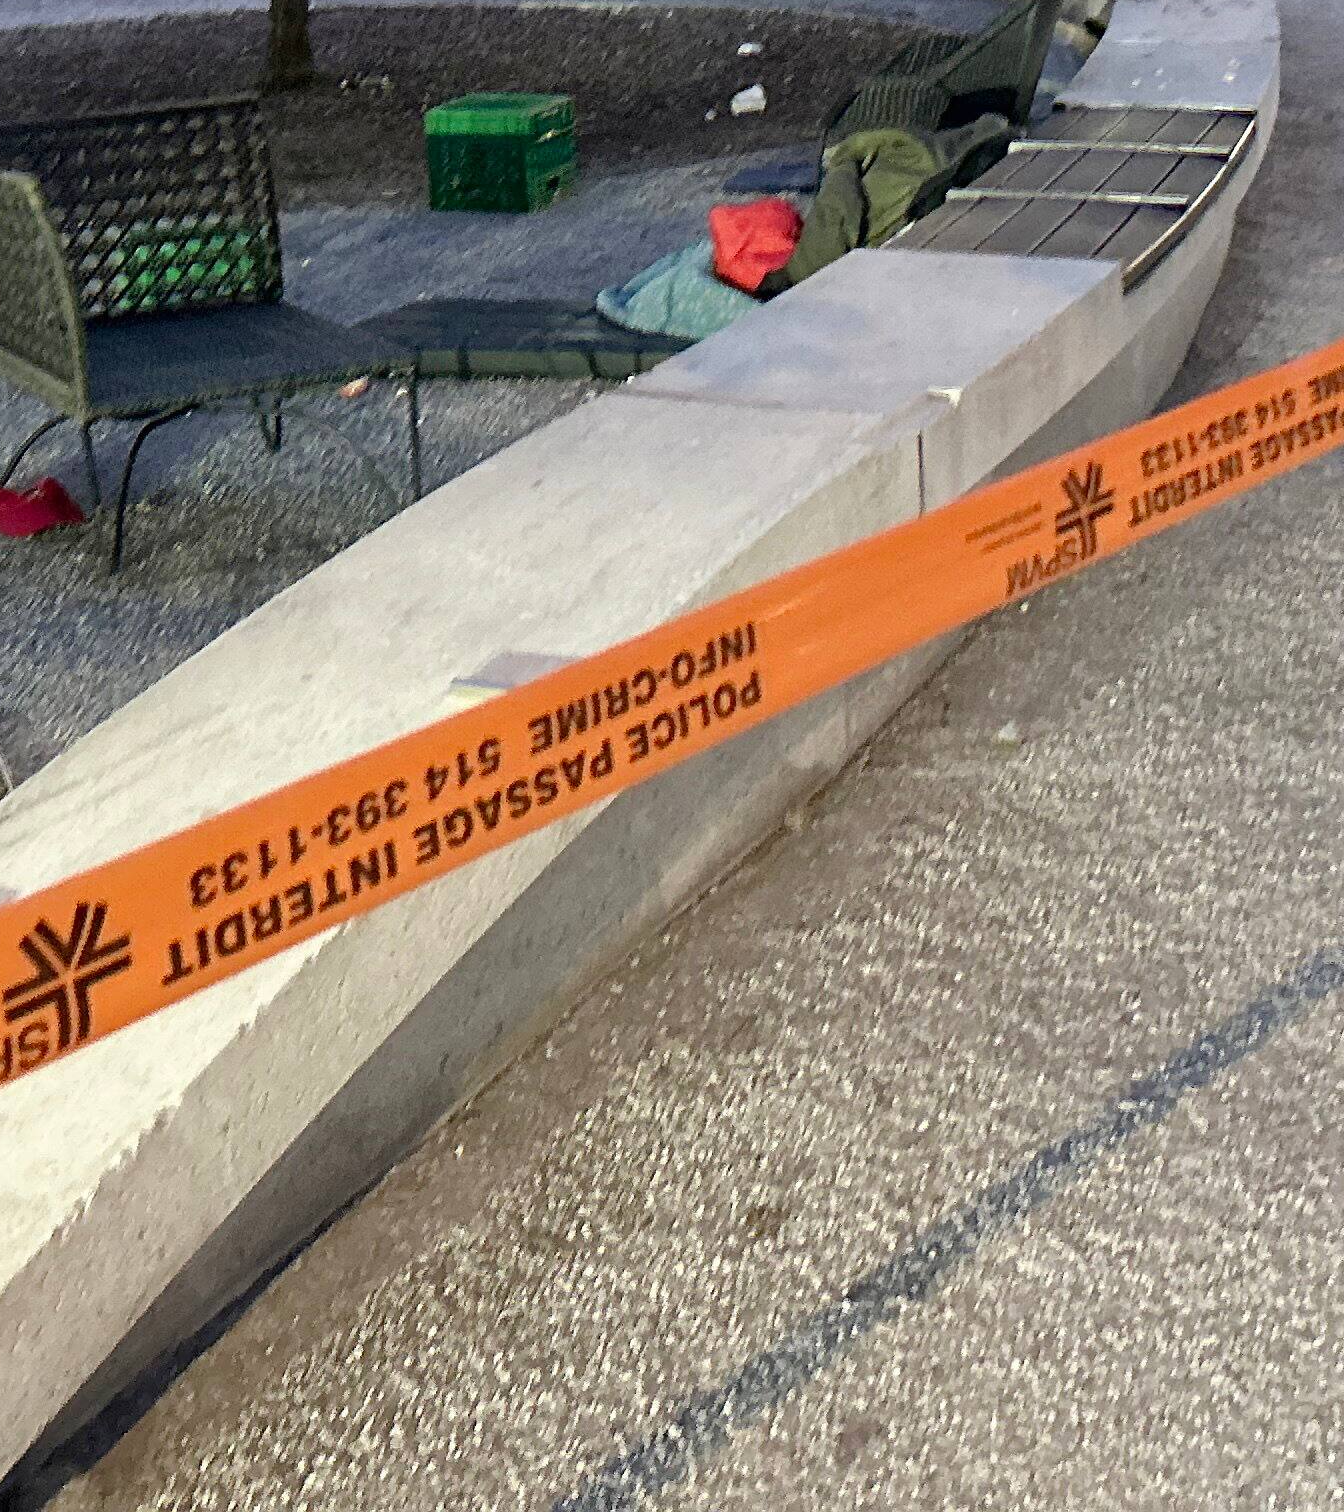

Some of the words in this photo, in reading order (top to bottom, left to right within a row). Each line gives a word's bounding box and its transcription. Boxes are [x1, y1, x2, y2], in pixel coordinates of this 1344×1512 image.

[1128, 450, 1244, 528] INTERDIT
[527, 621, 757, 756] INFO-CRIME
[625, 670, 762, 763] POLICE
[413, 738, 614, 865] PASSAGE
[423, 737, 502, 802] 514
[189, 777, 409, 910] 393-1133
[161, 839, 397, 985] INTERDIT
